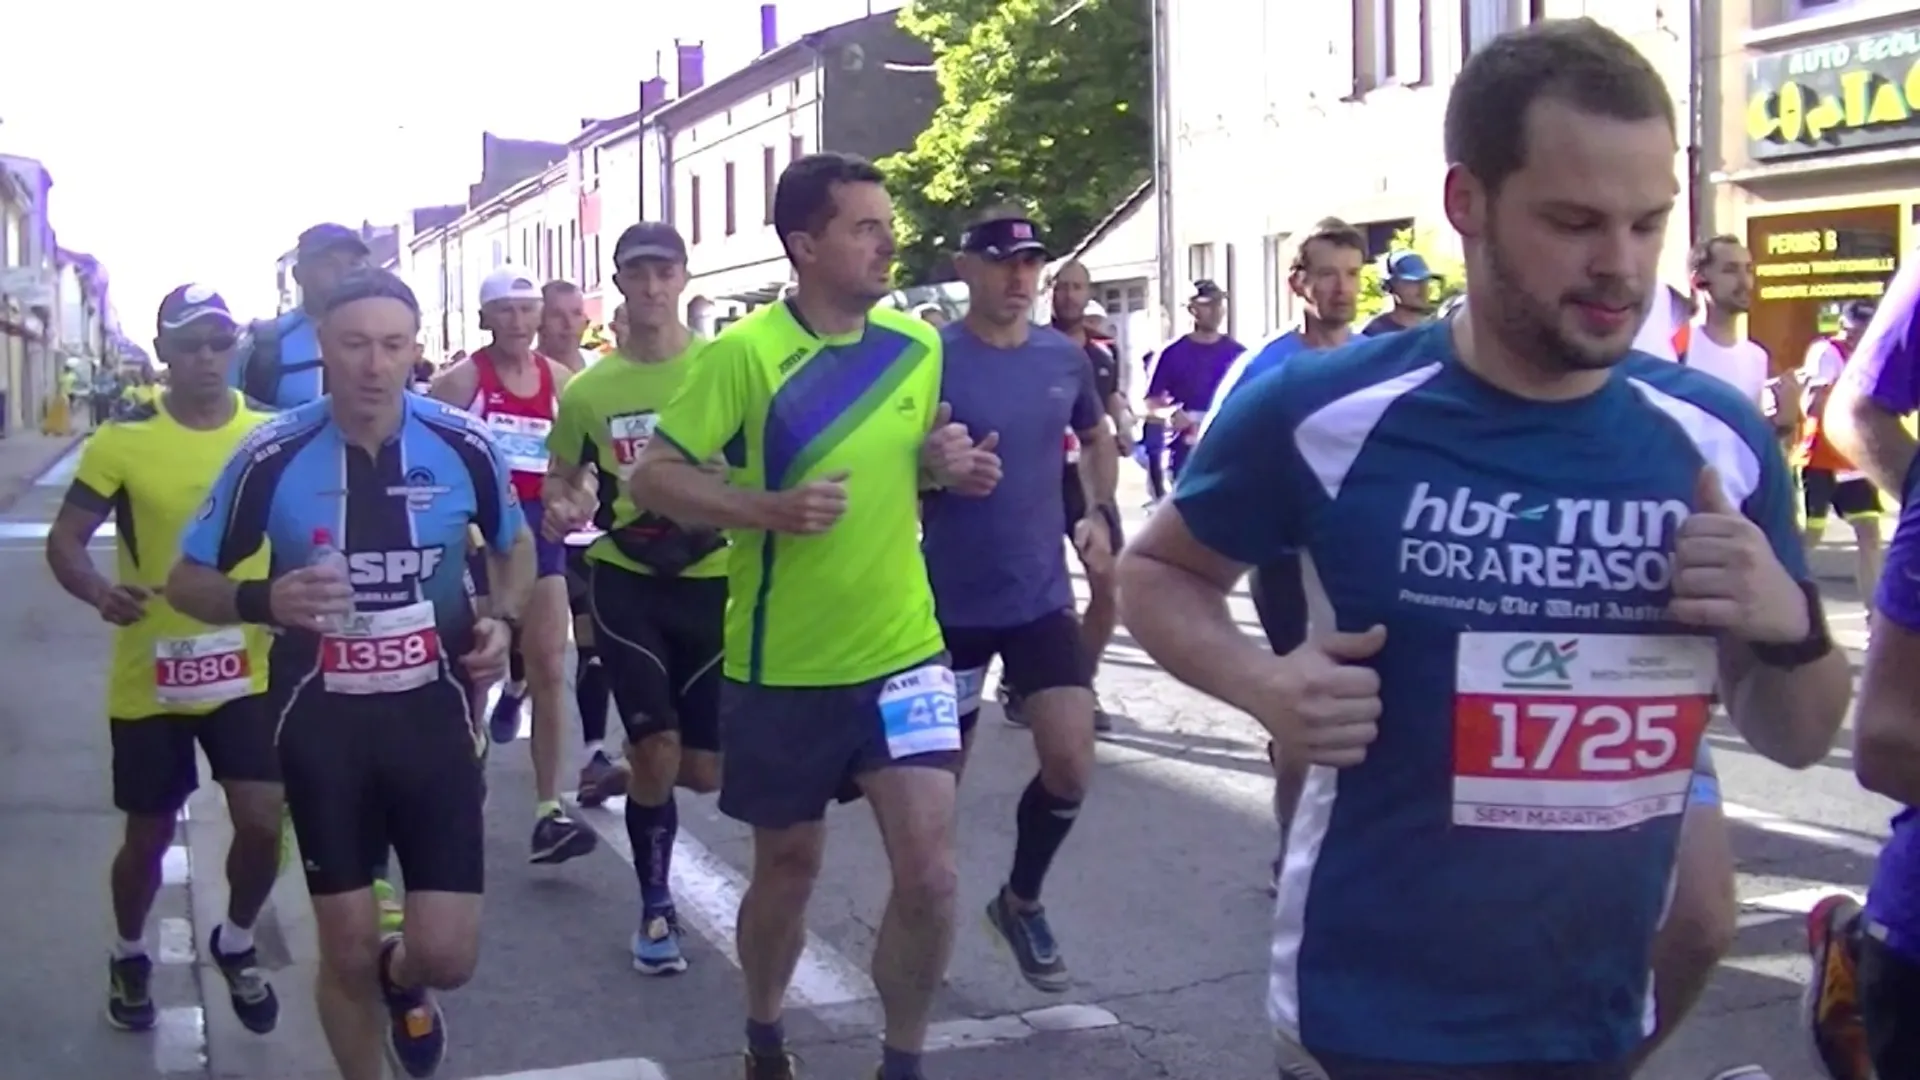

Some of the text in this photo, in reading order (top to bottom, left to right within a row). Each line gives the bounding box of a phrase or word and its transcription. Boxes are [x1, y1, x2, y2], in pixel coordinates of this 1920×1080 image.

[1789, 43, 1850, 74] AUTO
[1402, 482, 1522, 539] hbf
[1400, 537, 1675, 592] FOR A REASO
[1399, 588, 1475, 611] Presented
[1477, 597, 1498, 616] by
[1500, 595, 1540, 617] The
[165, 653, 241, 685] 1680
[335, 635, 428, 671] 1358
[1489, 702, 1678, 773] 1725
